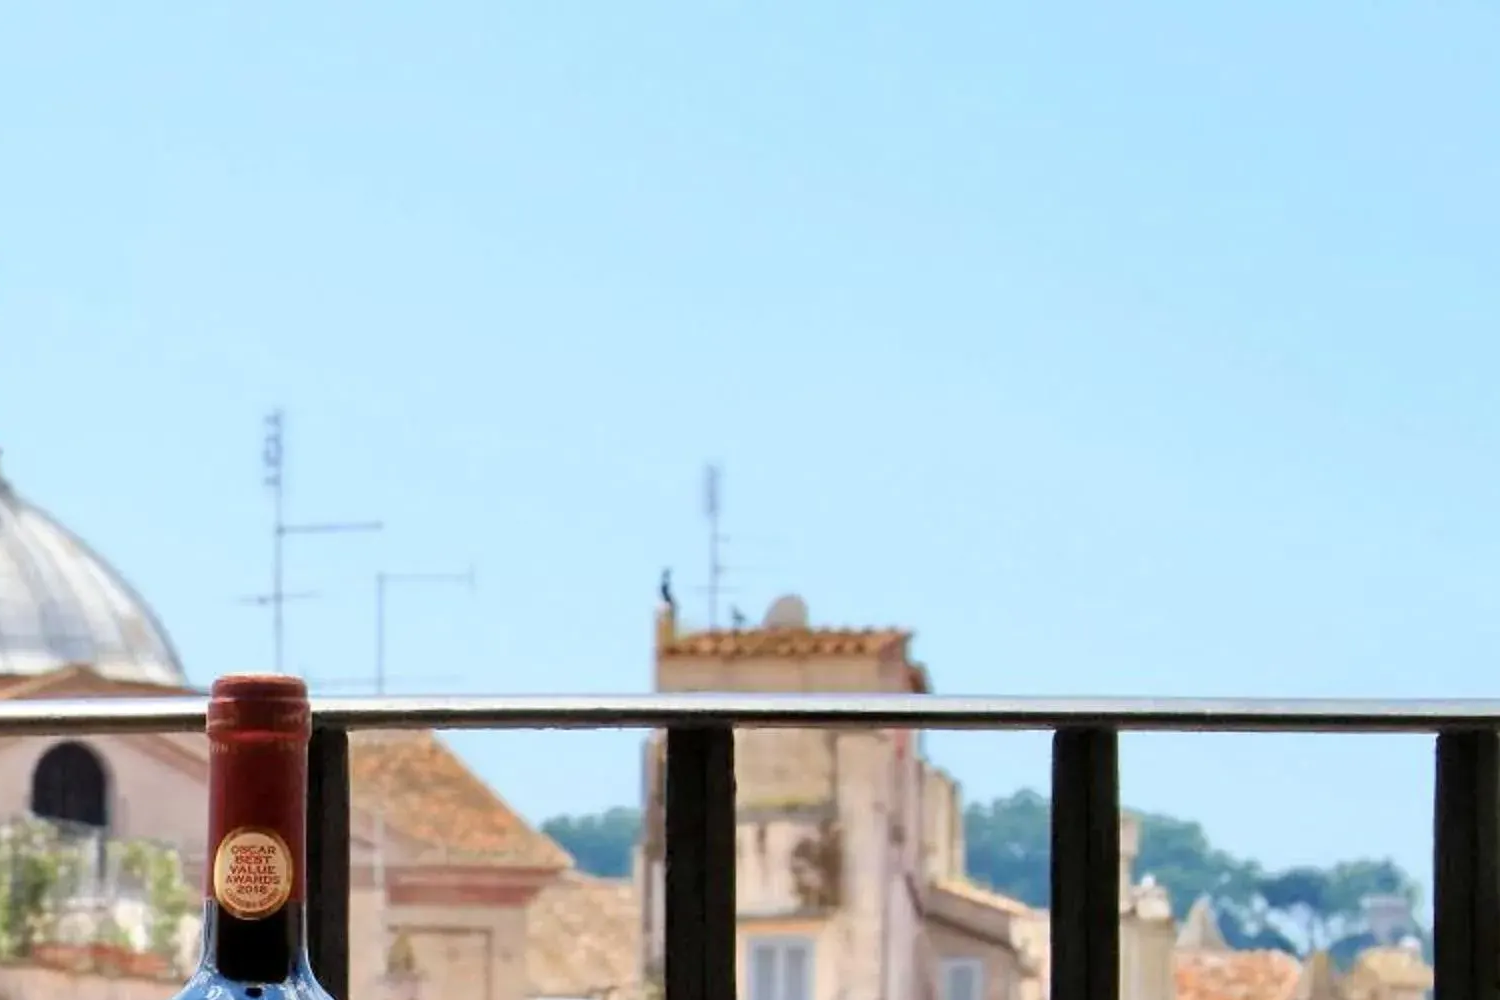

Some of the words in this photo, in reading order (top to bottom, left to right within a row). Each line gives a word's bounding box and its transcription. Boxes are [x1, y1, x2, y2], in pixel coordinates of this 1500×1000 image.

[231, 845, 277, 855] OSCAR
[235, 855, 273, 864] BEST
[230, 865, 277, 874] VALUE
[226, 875, 281, 885] AWARDS
